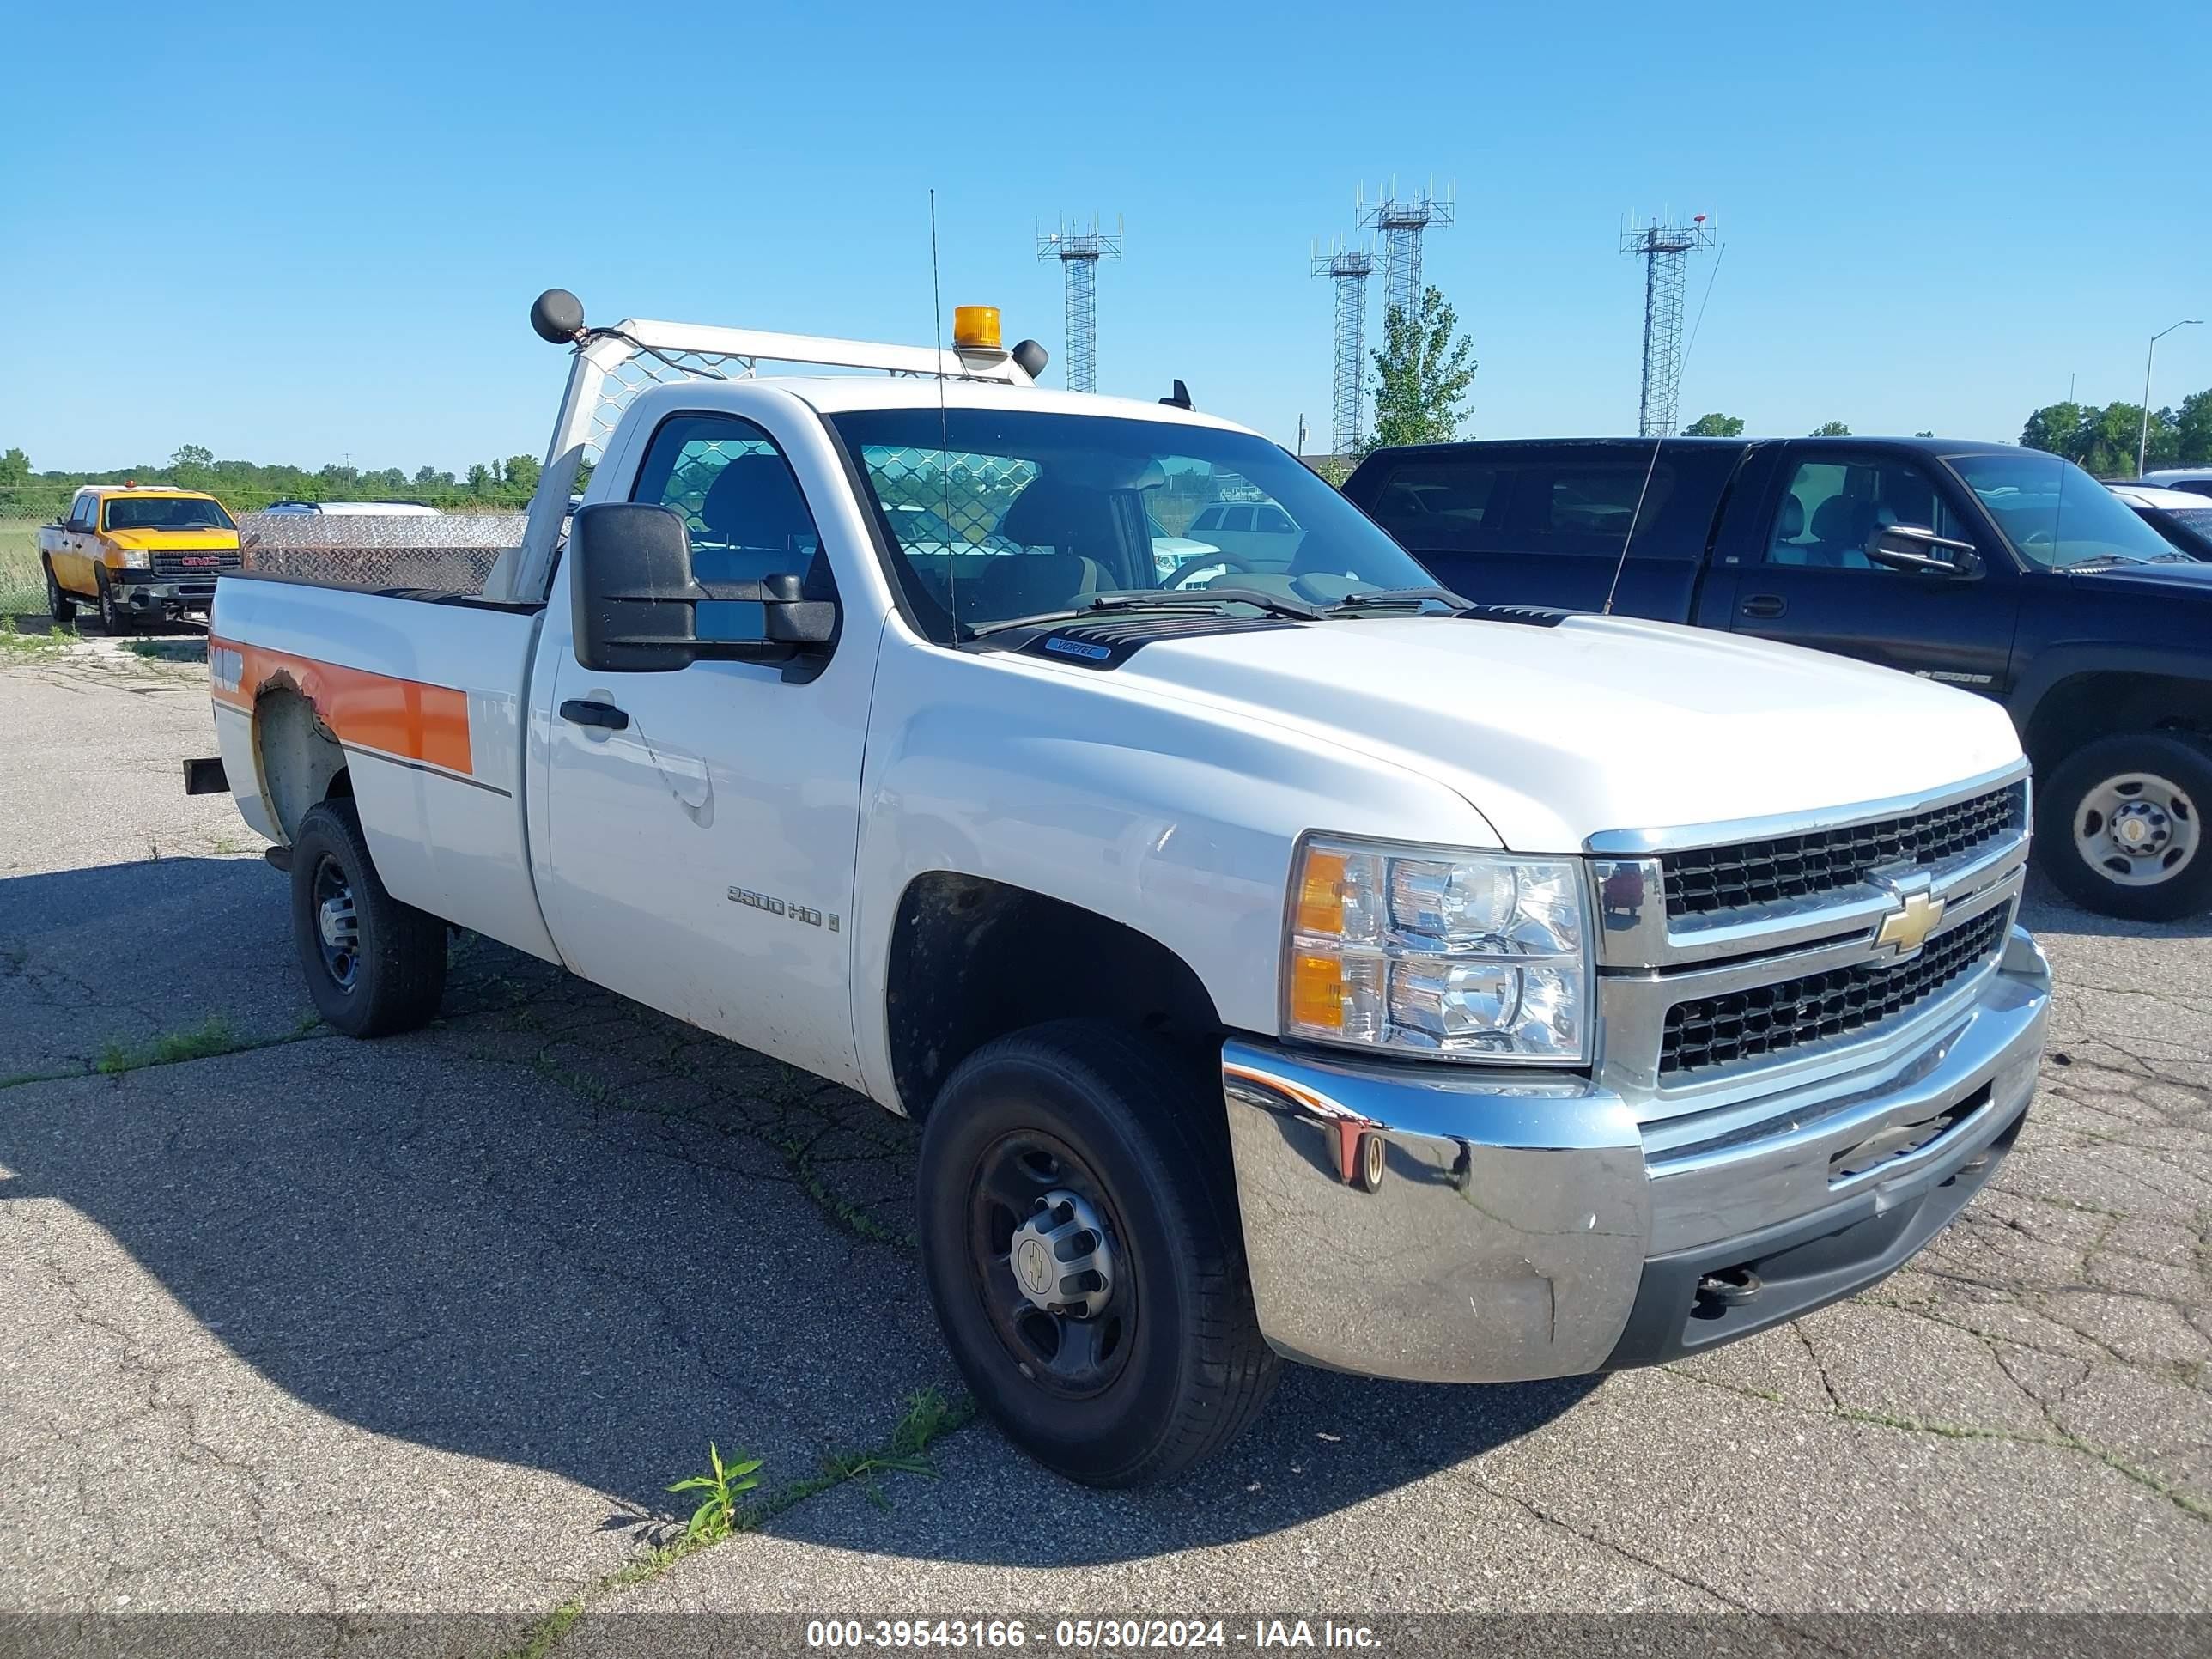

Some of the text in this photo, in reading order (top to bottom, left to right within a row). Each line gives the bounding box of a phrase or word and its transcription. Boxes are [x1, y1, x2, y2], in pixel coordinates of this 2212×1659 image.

[181, 556, 221, 567] GMC
[1057, 640, 1100, 655] VORTEC
[787, 902, 822, 927] HD
